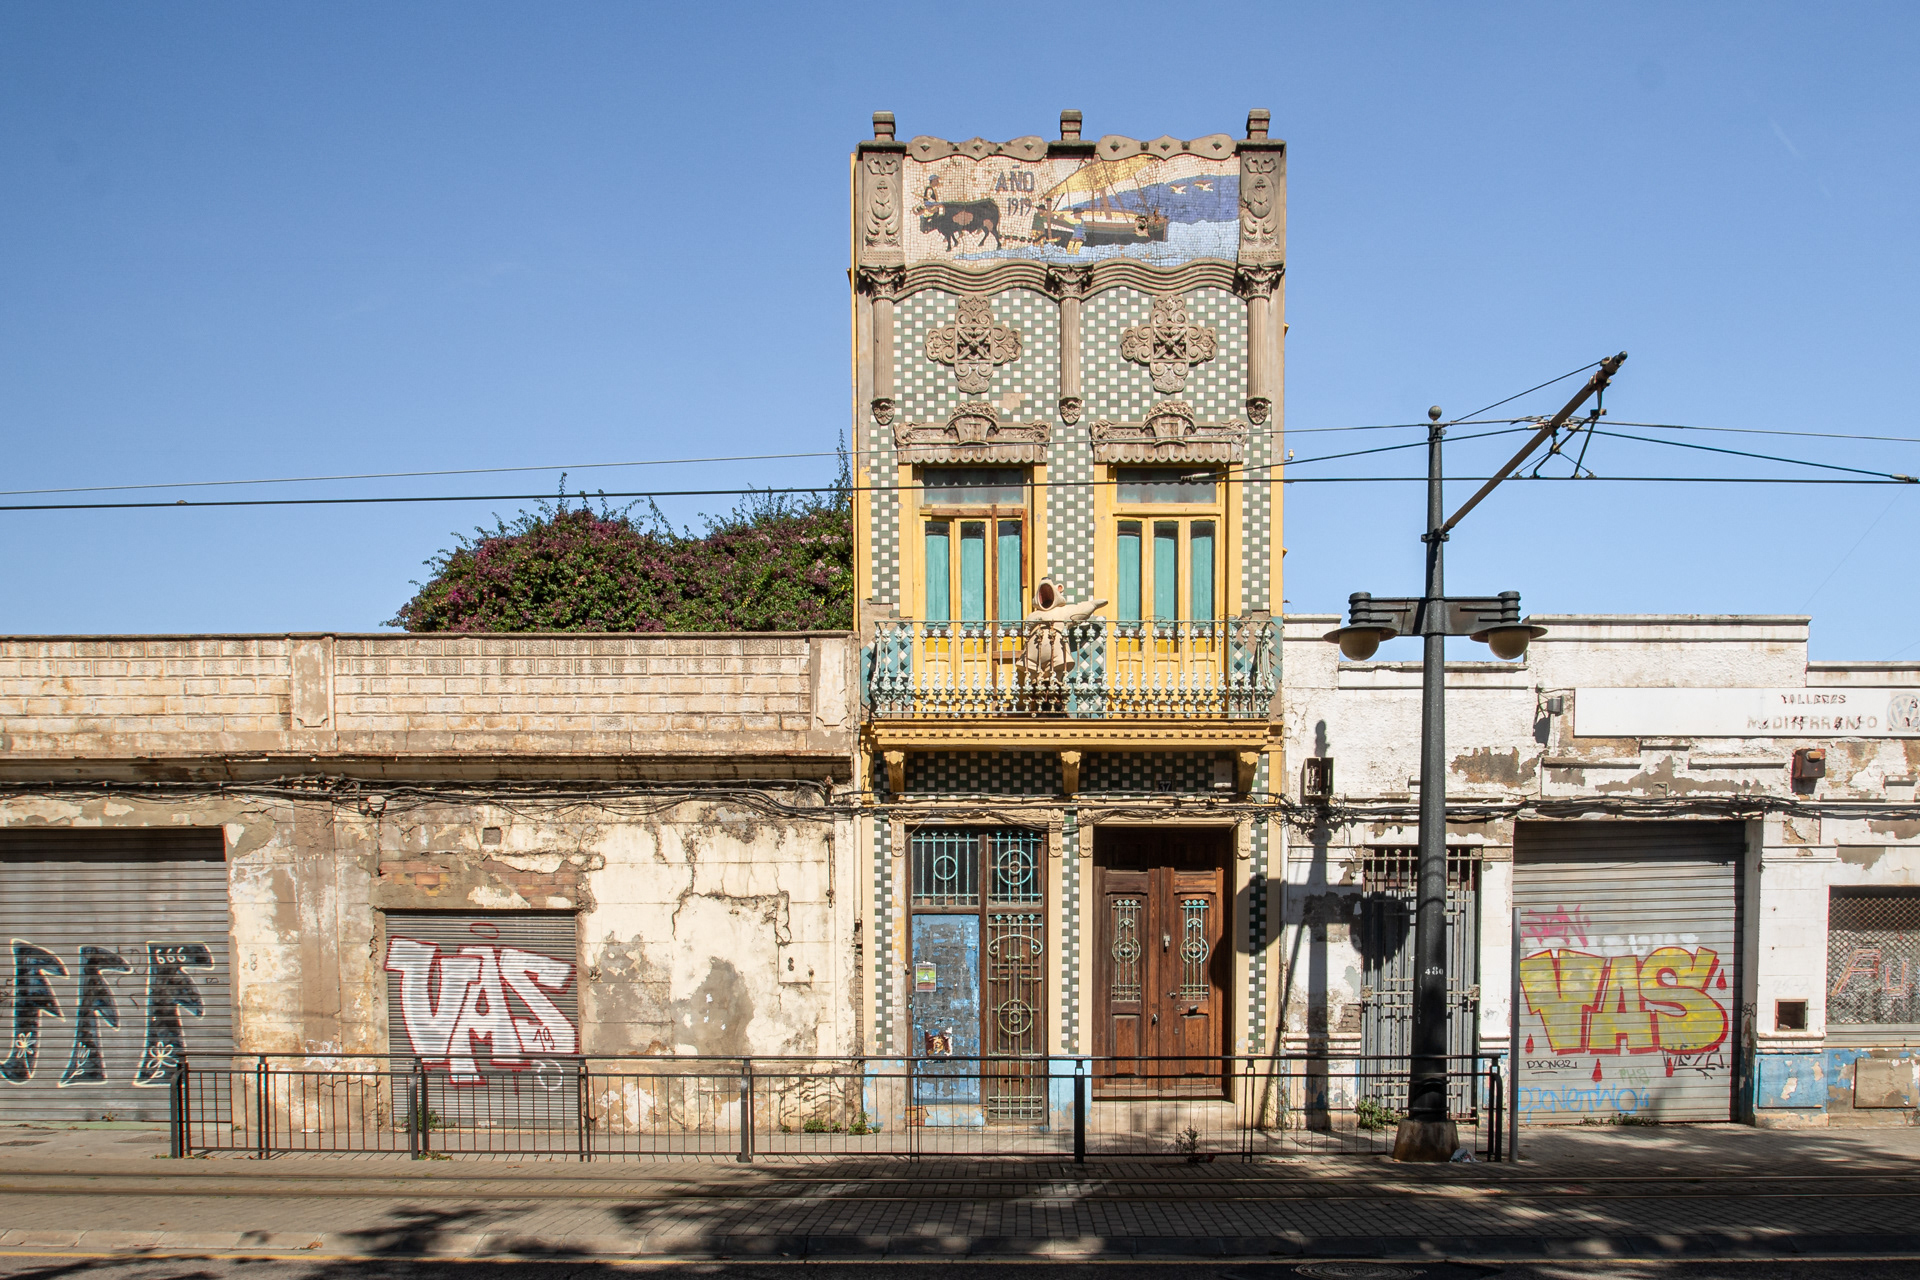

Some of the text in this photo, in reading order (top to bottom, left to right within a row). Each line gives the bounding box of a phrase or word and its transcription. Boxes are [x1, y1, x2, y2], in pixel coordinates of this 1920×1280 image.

[995, 165, 1034, 191] AÑO
[1007, 198, 1032, 216] 1919
[156, 947, 187, 964] 666
